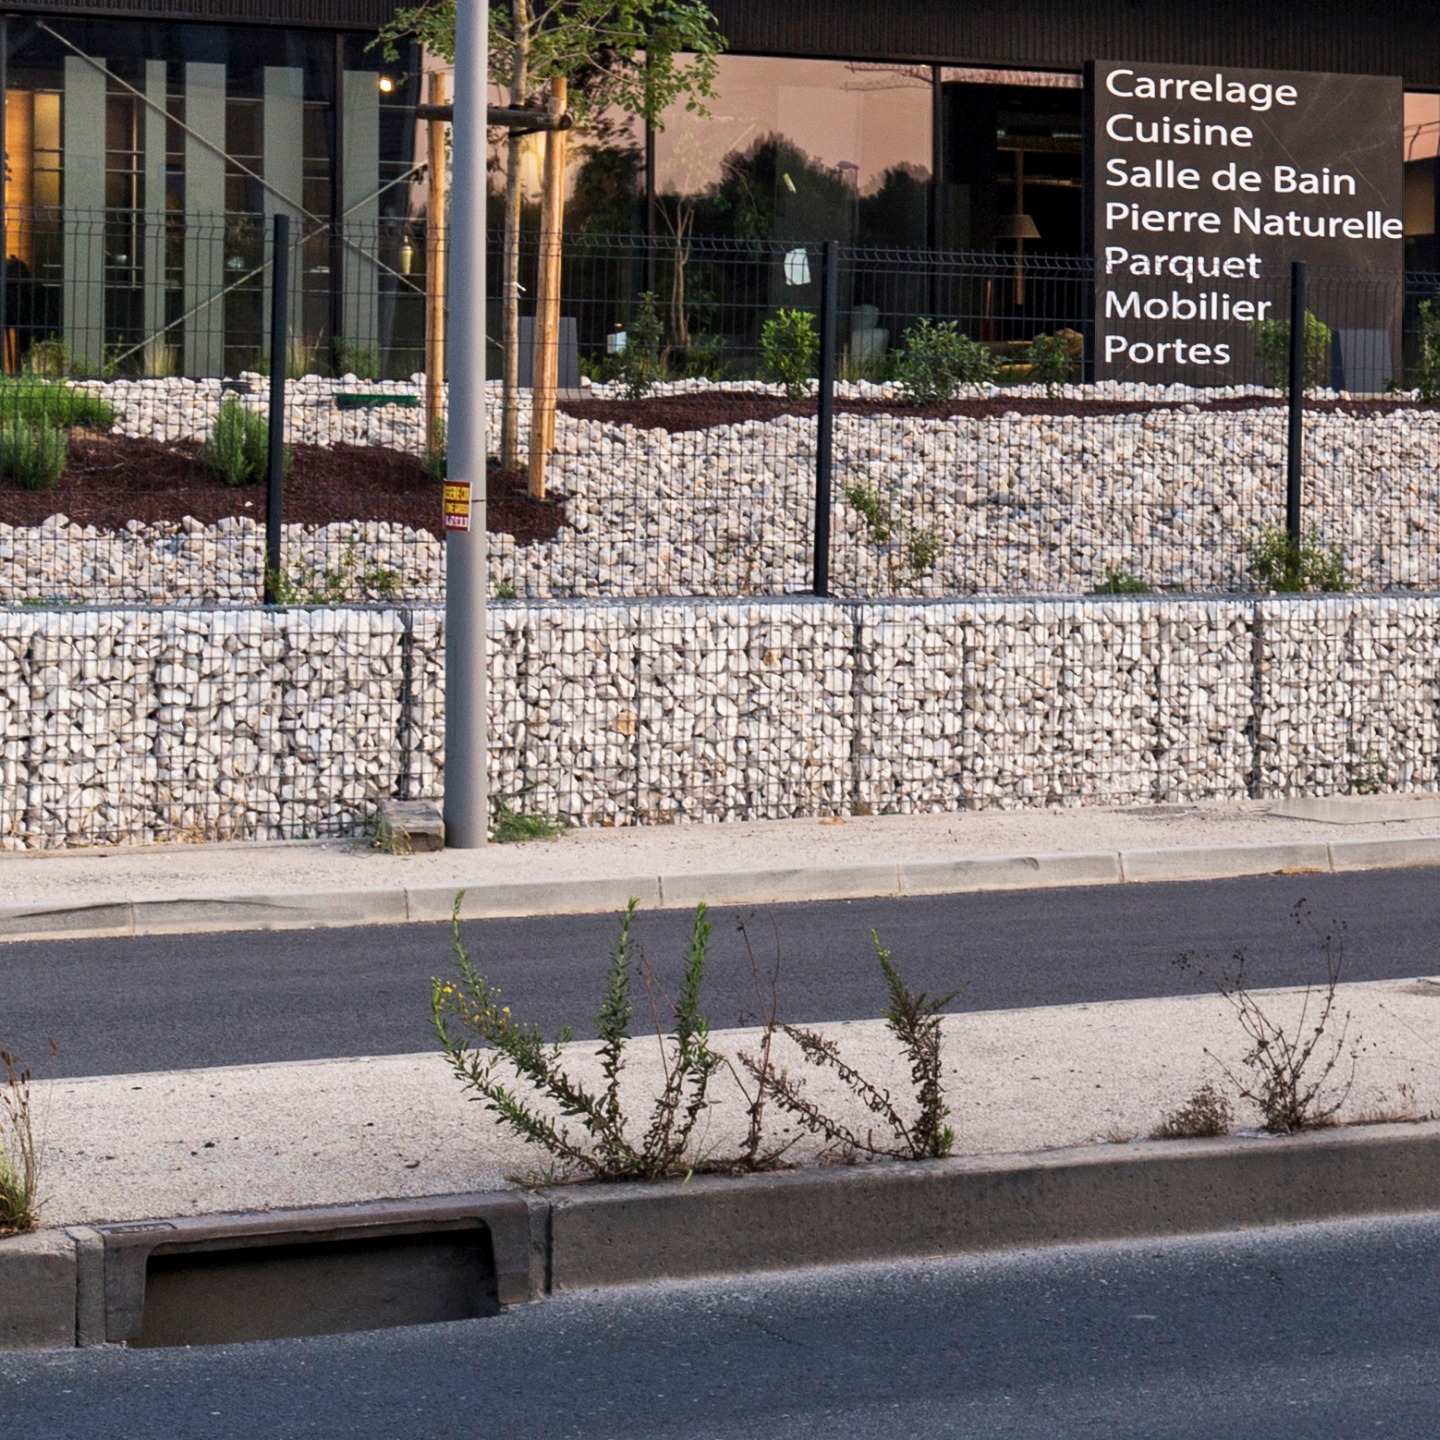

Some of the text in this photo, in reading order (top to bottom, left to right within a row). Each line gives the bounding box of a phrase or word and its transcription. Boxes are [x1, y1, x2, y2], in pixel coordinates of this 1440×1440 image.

[1105, 69, 1298, 112] Carrelage
[1105, 113, 1254, 148] Cuisine
[1105, 158, 1356, 196] Salle de Bain
[1105, 202, 1404, 239] Pierre Naturelle
[1104, 246, 1263, 284] Parquet
[1104, 290, 1272, 322] Mobilier
[1104, 335, 1231, 365] Portes
